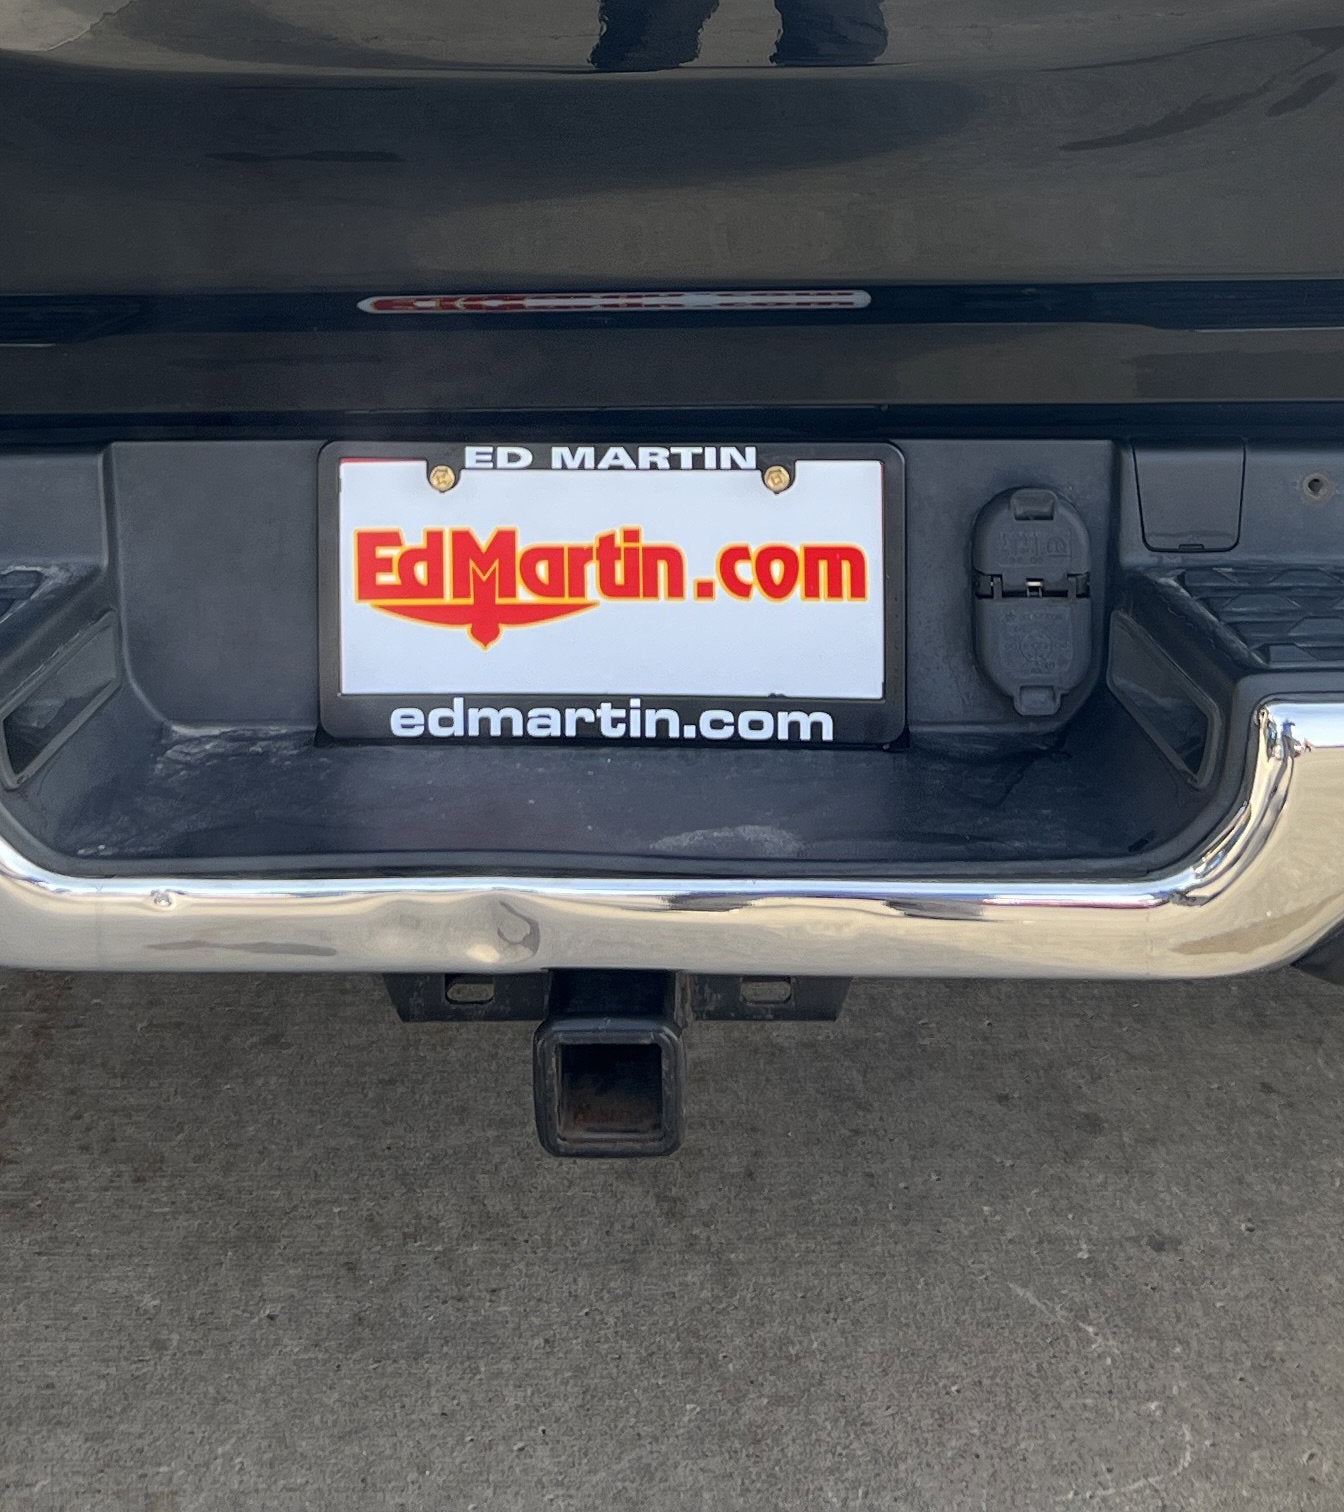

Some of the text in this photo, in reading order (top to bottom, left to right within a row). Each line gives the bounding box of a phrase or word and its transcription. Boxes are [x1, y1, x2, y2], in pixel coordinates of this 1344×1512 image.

[464, 445, 758, 471] ED MARTIN
[353, 525, 869, 603] EdMartin.com
[390, 696, 835, 742] edmartin.com
